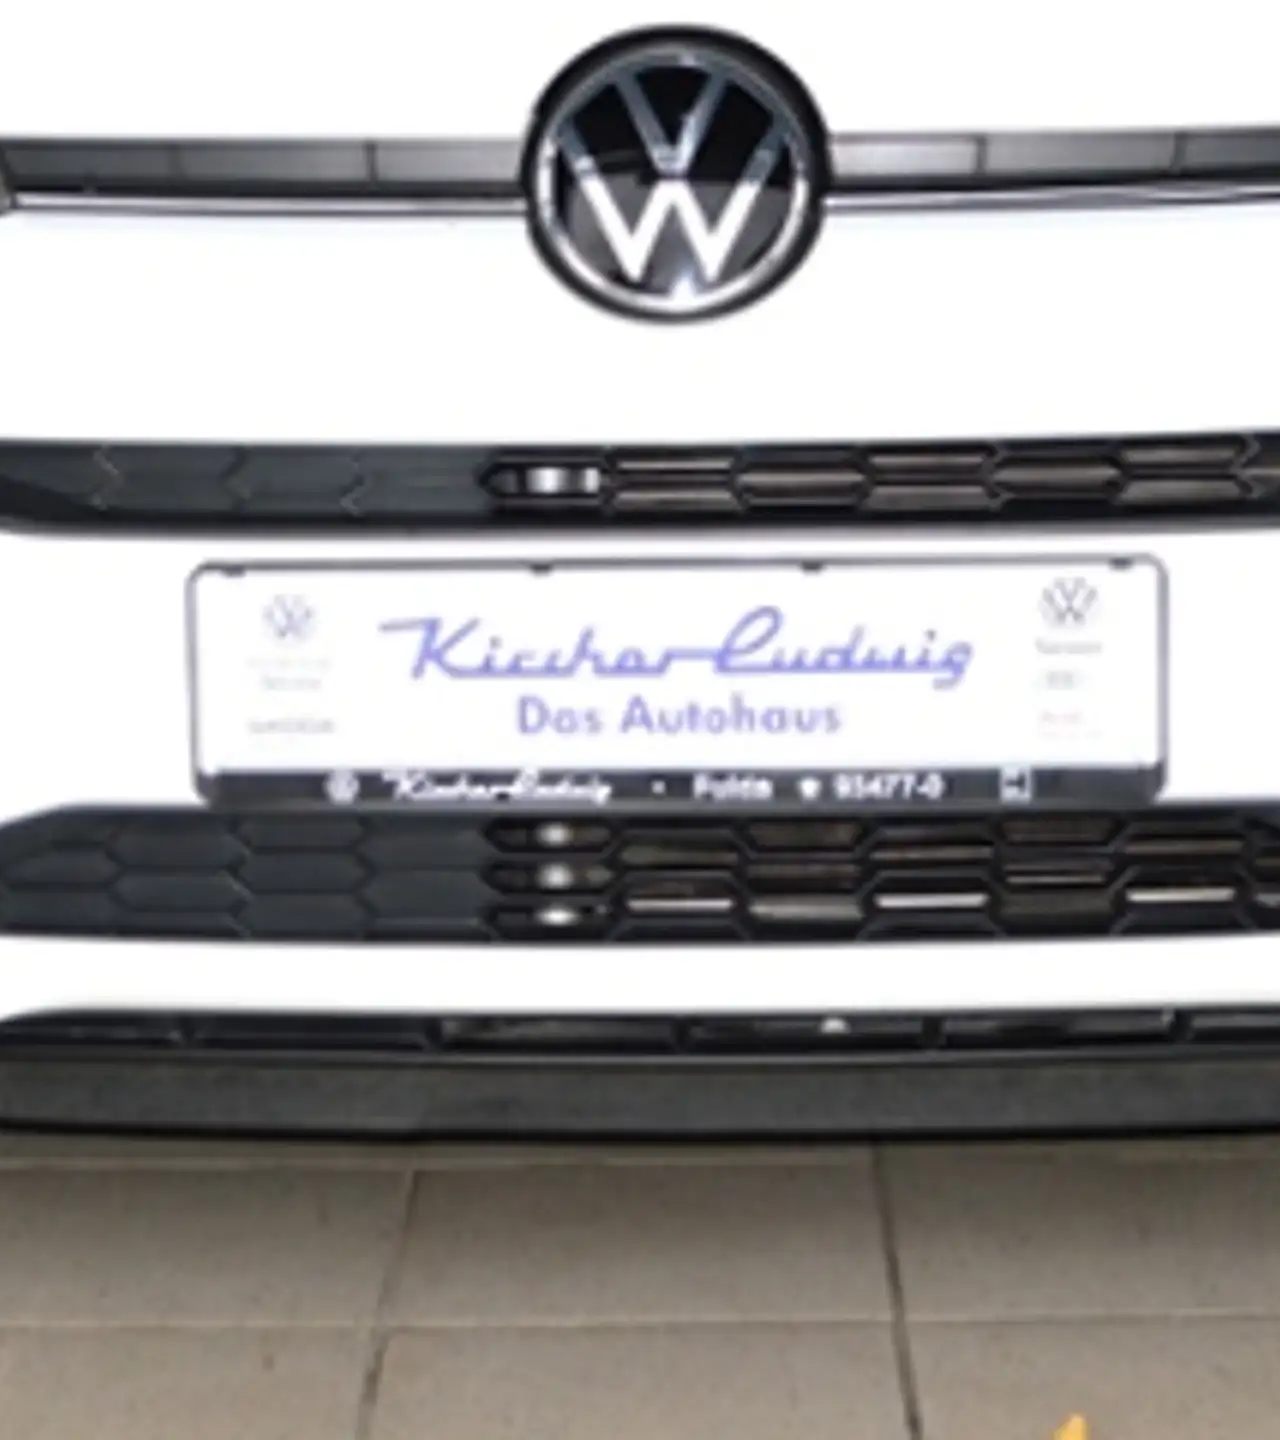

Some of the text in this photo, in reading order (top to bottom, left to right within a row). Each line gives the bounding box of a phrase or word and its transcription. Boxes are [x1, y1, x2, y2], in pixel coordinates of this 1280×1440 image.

[544, 52, 800, 298] VW
[516, 691, 842, 736] Das Autohaus
